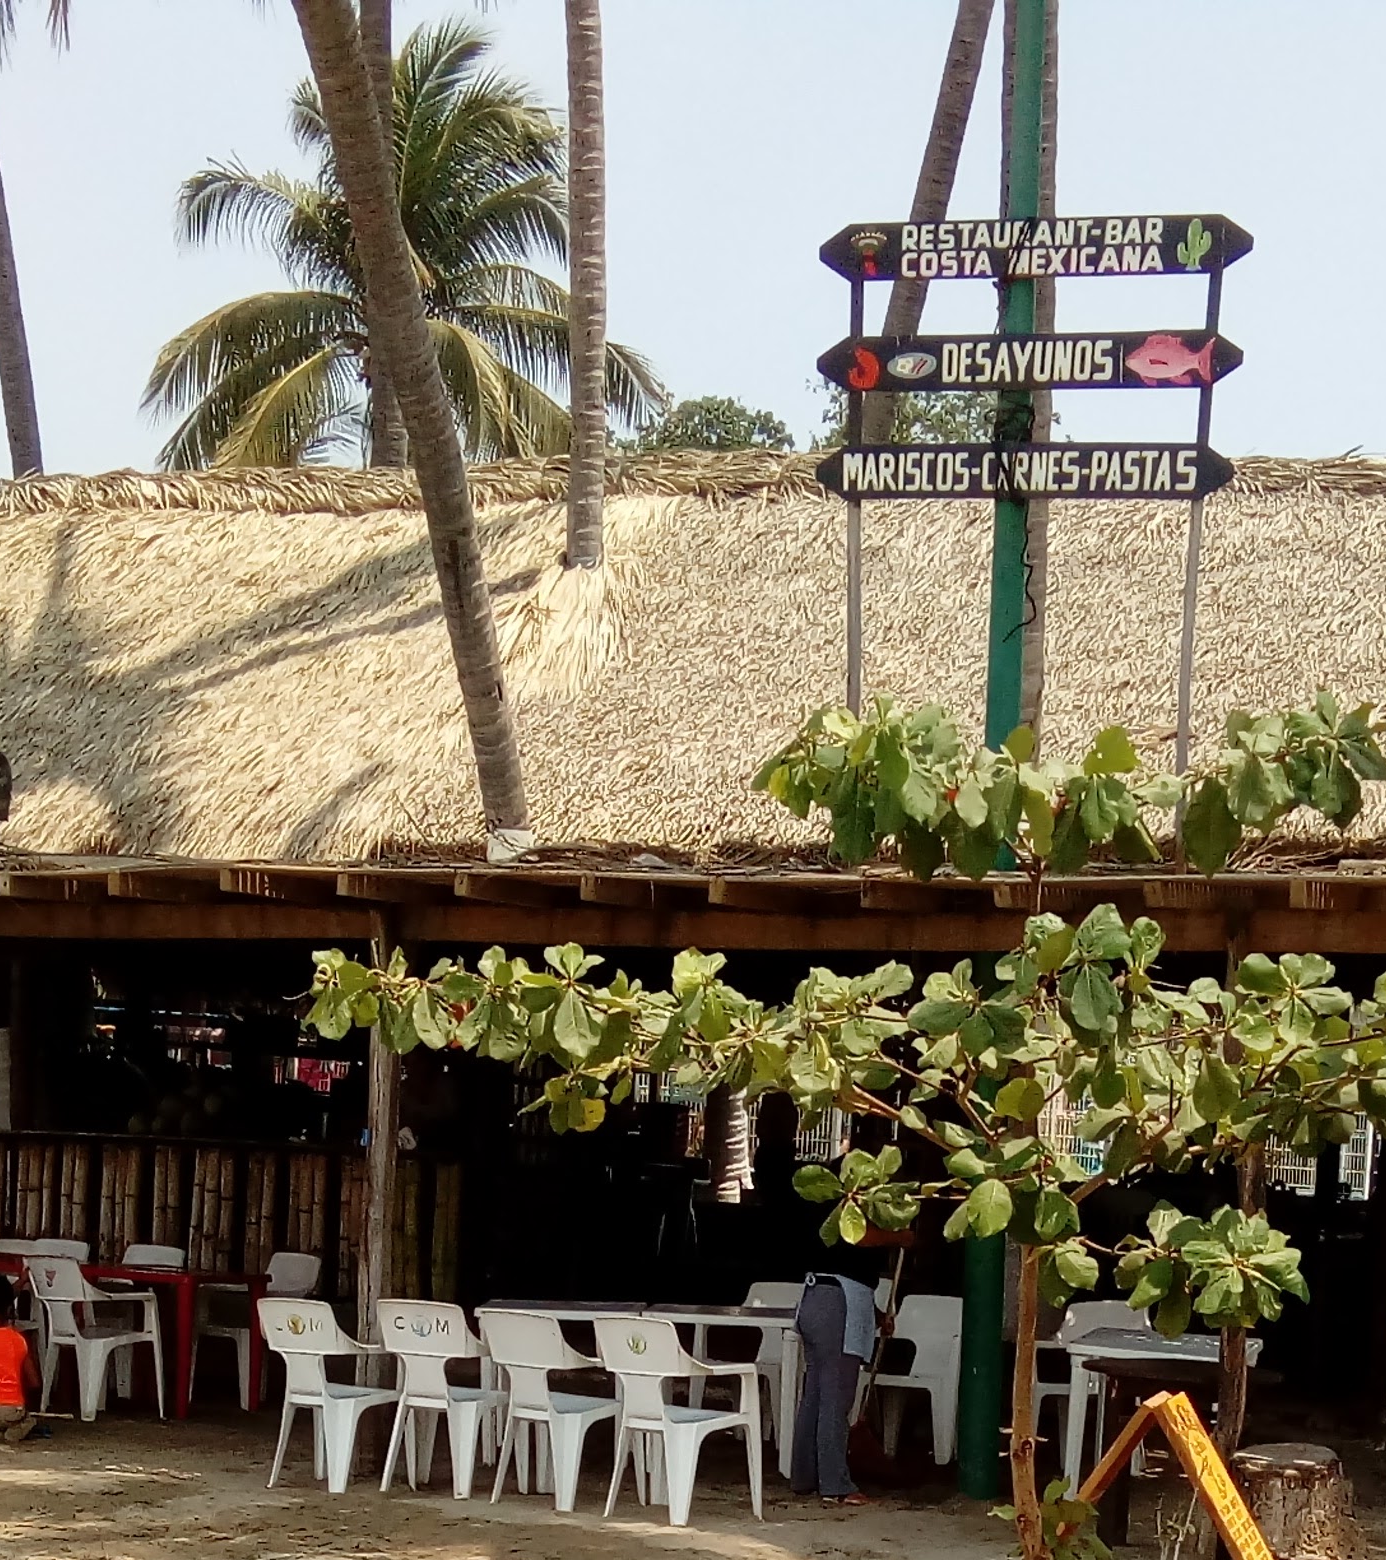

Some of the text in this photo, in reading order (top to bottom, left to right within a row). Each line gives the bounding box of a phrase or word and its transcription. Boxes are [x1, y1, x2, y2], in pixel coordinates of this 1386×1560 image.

[901, 217, 1164, 252] RESTAURANT-BAR
[901, 246, 1164, 277] COSTA MEXICANA
[941, 339, 1114, 383] DESAYUNOS
